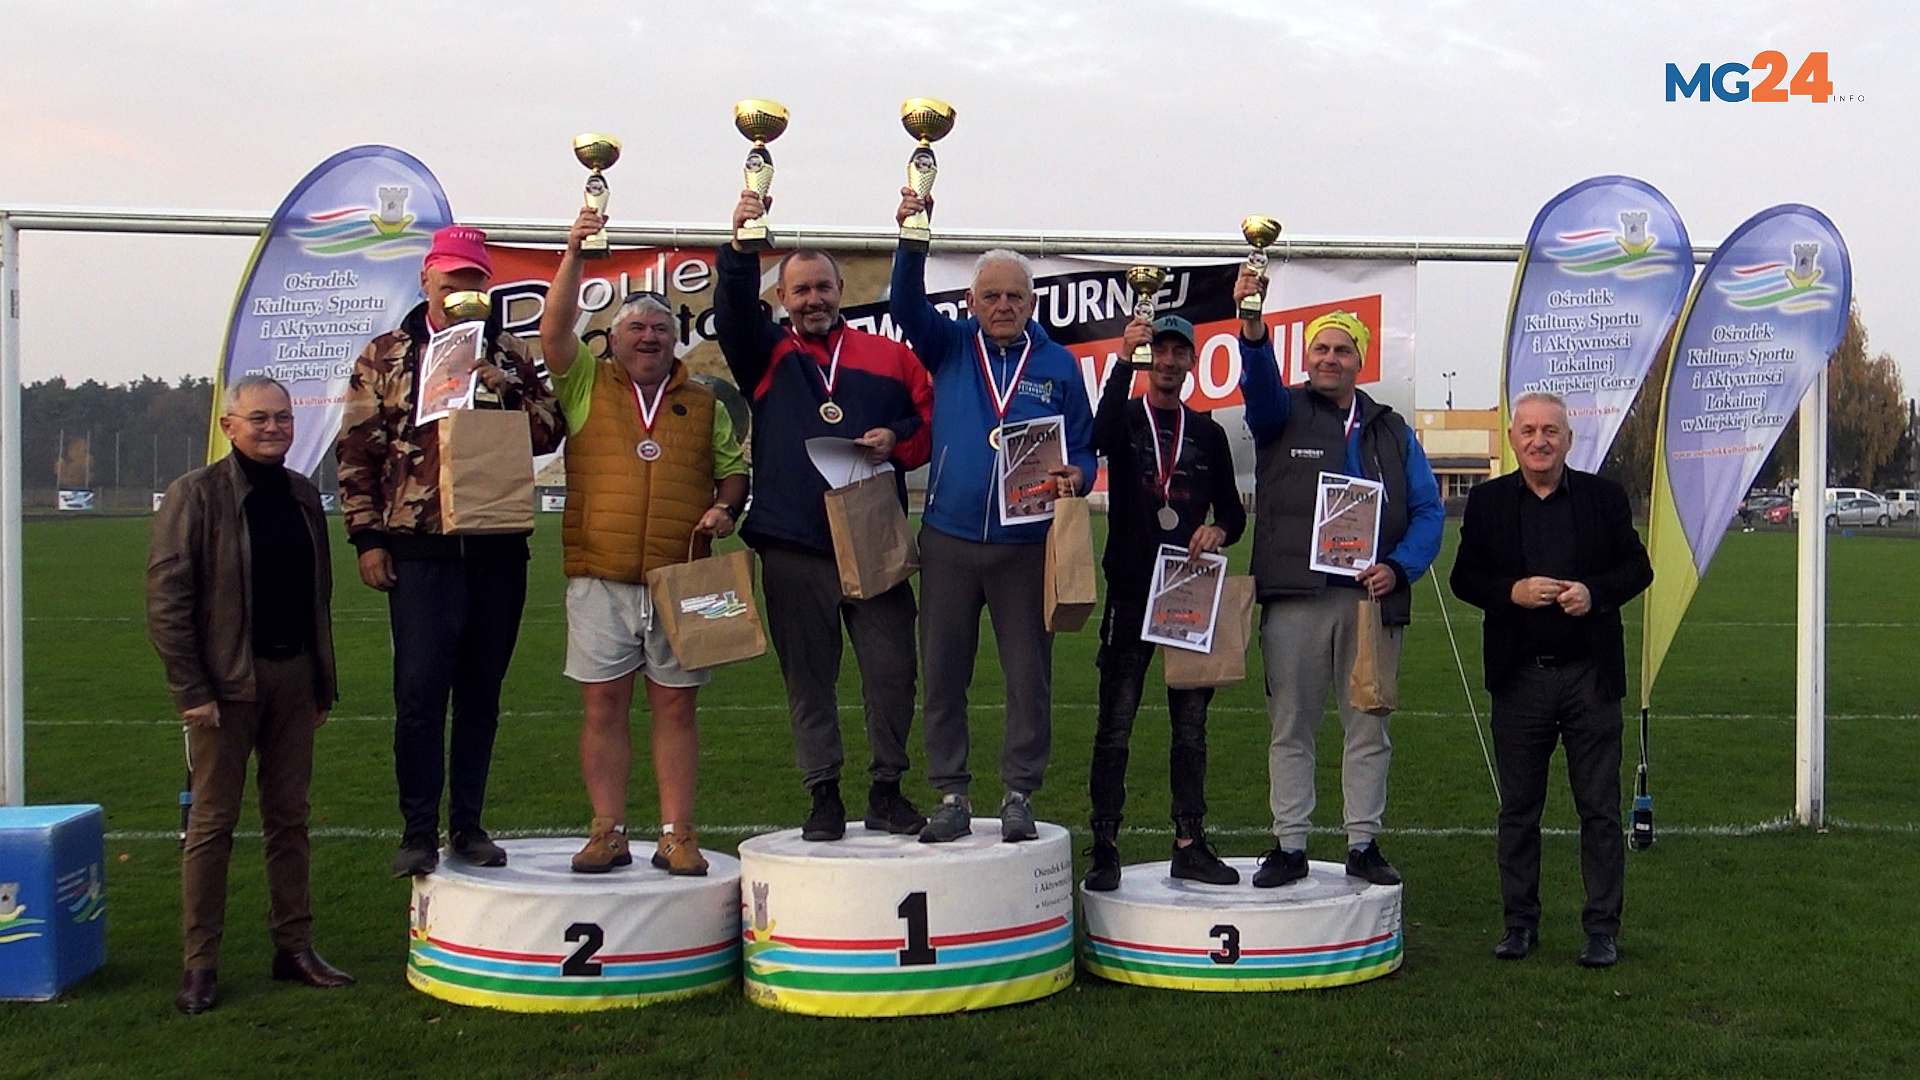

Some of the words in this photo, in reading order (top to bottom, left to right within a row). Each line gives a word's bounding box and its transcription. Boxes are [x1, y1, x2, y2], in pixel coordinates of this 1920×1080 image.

[286, 271, 358, 289] Ośrodek
[255, 297, 321, 316] Kultury,
[328, 295, 384, 314] Sportu
[1549, 288, 1613, 306] Ośrodek
[262, 321, 268, 337] i
[273, 318, 370, 339] Aktywności
[1526, 314, 1584, 332] Kultury,
[1590, 311, 1639, 330] Sportu
[1713, 322, 1773, 341] Ośrodek
[278, 341, 351, 360] Lokalnej
[1533, 337, 1540, 352] i
[1545, 332, 1631, 354] Aktywności
[1550, 355, 1614, 373] Lokalnej
[1688, 348, 1744, 367] Kultury,
[1748, 347, 1795, 366] Sportu
[264, 364, 328, 382] Miejskiej
[1693, 372, 1701, 389] i
[1703, 368, 1783, 390] Aktywności
[1540, 378, 1596, 394] Miejskiej
[1706, 391, 1766, 410] Lokalnej
[1681, 419, 1694, 431] w
[1695, 414, 1748, 432] Miejskiej
[1008, 430, 1057, 446] DYPLOM
[897, 891, 936, 966] 1
[562, 923, 604, 976] 2
[1209, 924, 1240, 965] 3
